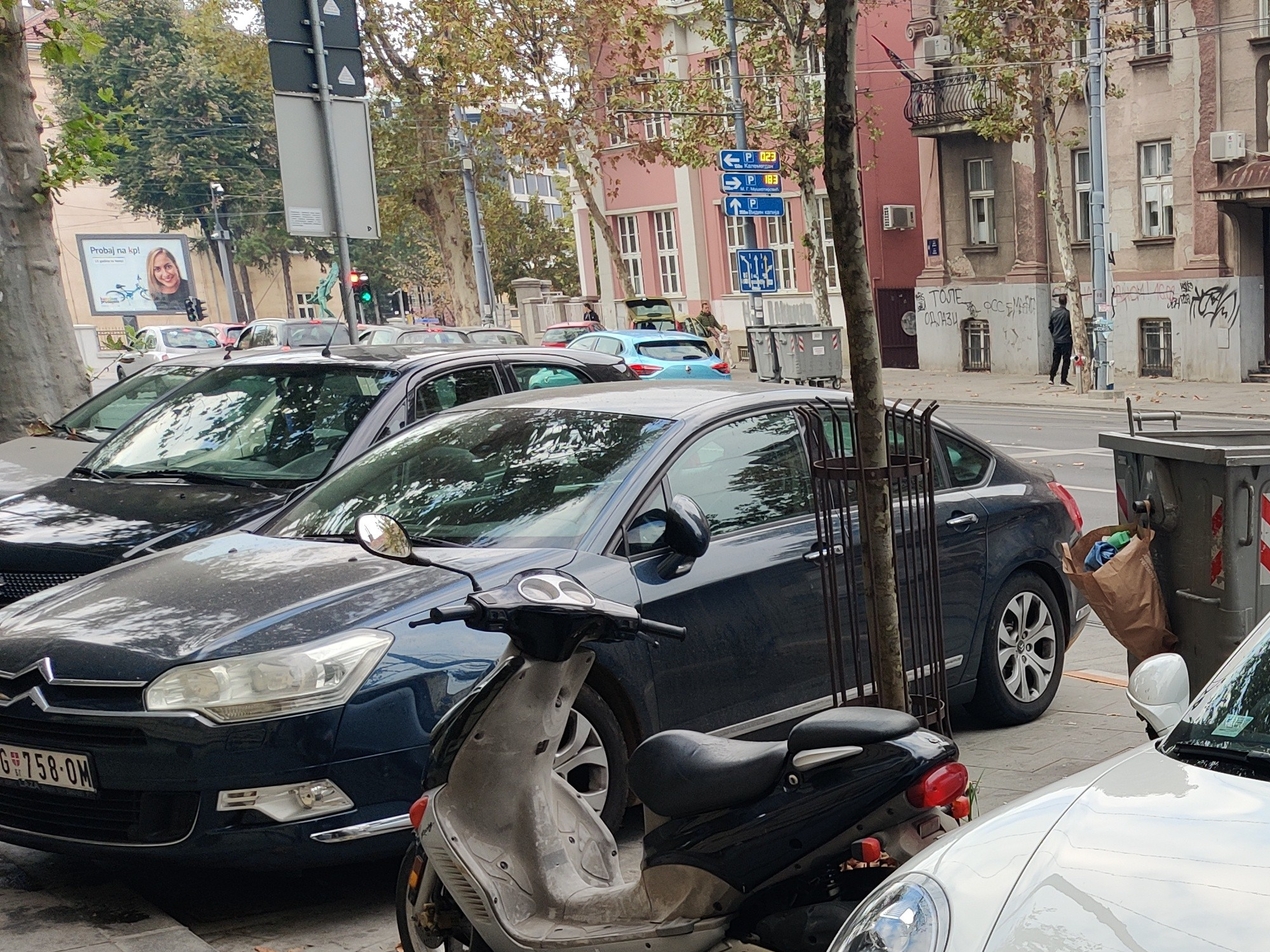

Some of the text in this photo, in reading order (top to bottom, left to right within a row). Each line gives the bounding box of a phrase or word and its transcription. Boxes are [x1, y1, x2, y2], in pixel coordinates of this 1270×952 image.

[760, 151, 777, 162] 023
[764, 174, 779, 185] 183
[90, 246, 115, 255] Probaj
[128, 246, 140, 255] kp!
